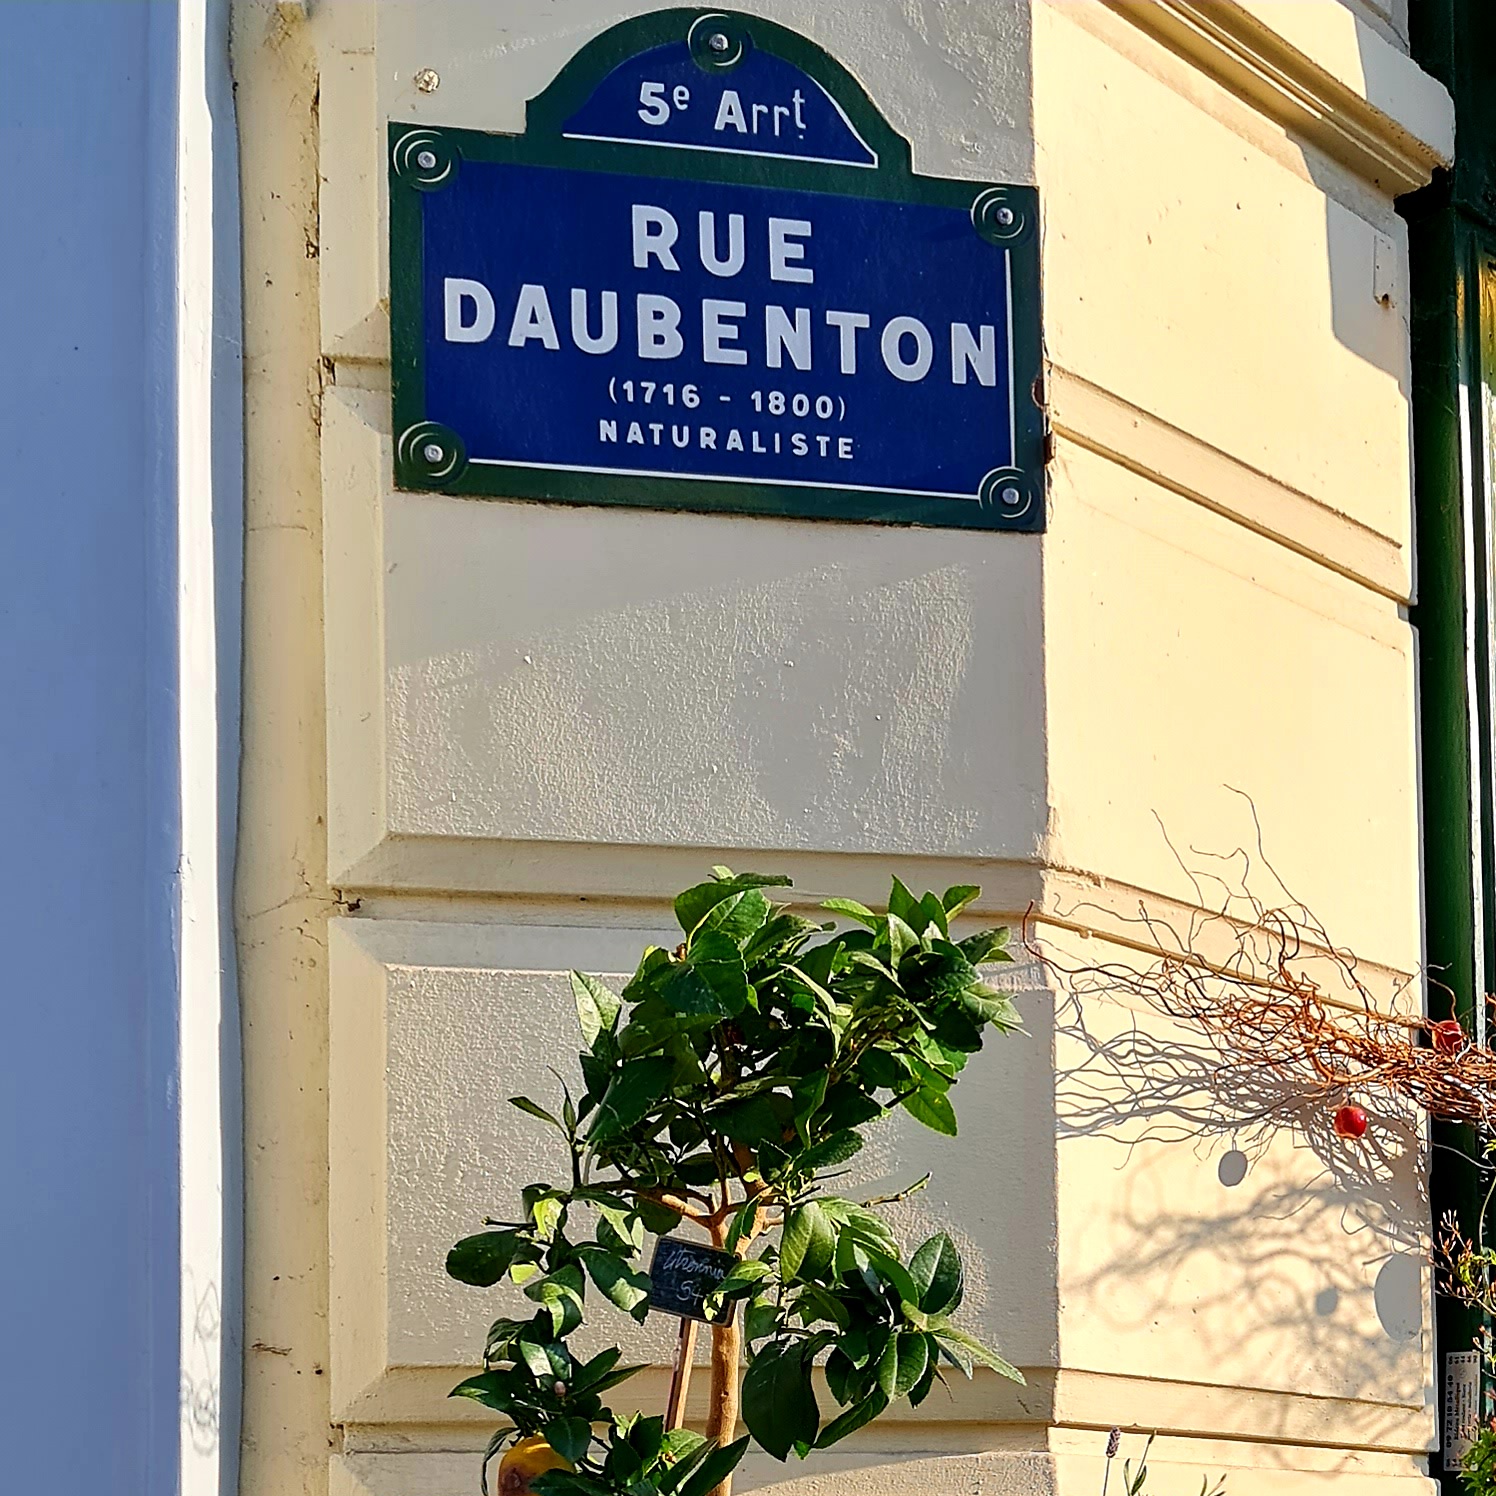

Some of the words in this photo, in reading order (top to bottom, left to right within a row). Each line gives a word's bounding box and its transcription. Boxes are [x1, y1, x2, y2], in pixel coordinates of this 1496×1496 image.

[714, 88, 808, 140] Arrt
[631, 203, 815, 284] RUE
[442, 276, 997, 388] DAUBENTON
[608, 377, 702, 409] (1716
[750, 390, 847, 422] 1800)
[599, 418, 857, 460] NATURALISTE
